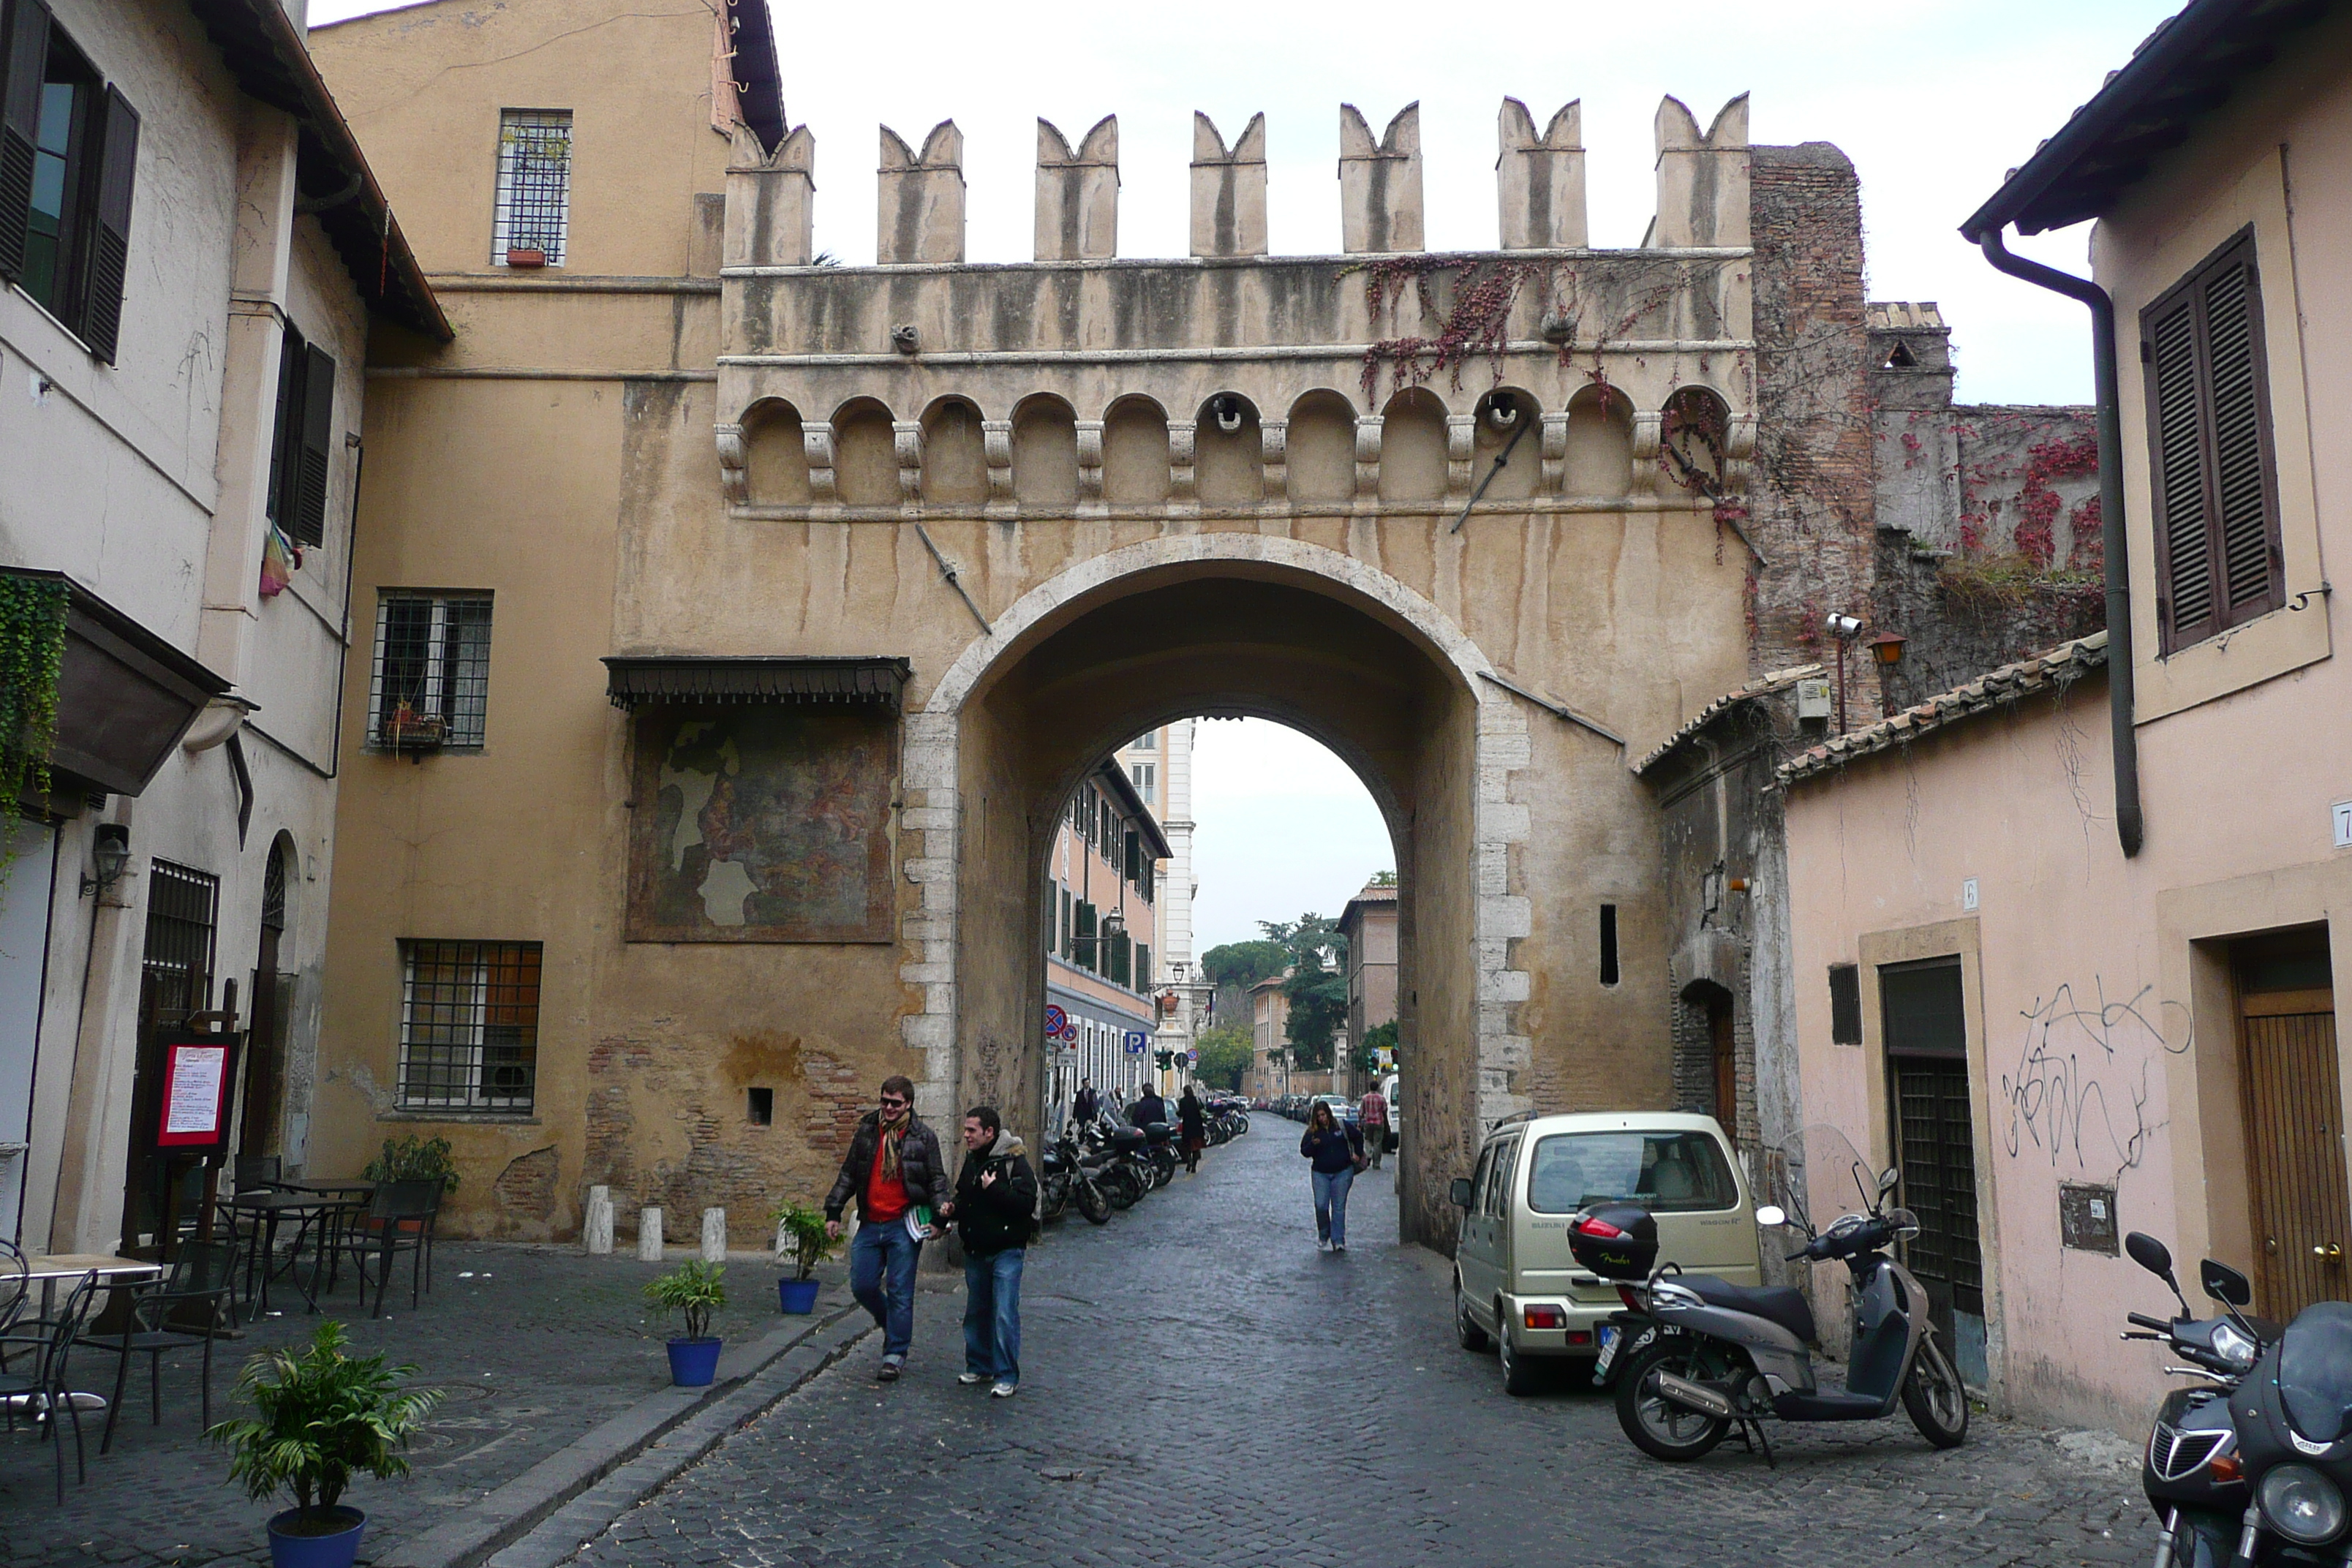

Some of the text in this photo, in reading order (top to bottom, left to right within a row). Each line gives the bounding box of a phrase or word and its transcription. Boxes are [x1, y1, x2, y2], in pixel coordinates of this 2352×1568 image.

[2340, 810, 2351, 838] 7
[1967, 883, 1975, 905] 6
[1130, 1034, 1142, 1051] P
